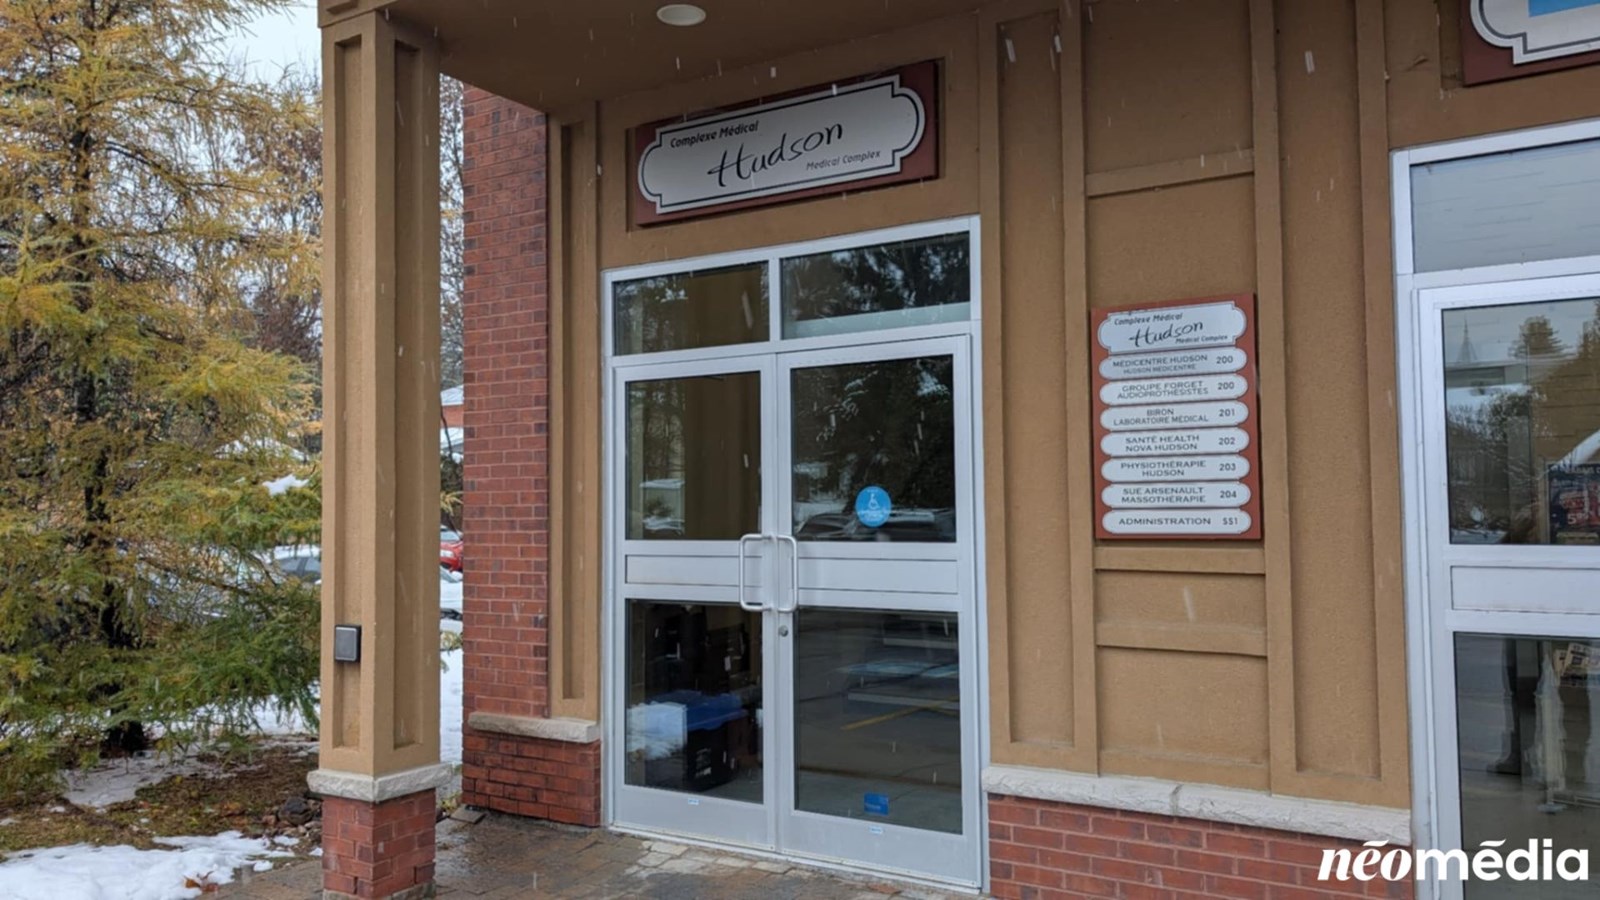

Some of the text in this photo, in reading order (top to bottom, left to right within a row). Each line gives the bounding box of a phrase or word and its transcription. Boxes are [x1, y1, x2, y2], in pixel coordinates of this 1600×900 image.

[670, 120, 759, 149] Complexe Médical
[707, 123, 843, 187] Hudson
[806, 150, 881, 171] Medical Complex
[1114, 312, 1183, 326] Complexe Médical
[1128, 321, 1204, 347] Hudson
[1175, 336, 1200, 344] Medical
[1170, 354, 1208, 363] HUDSON
[1216, 355, 1234, 364] 200
[1122, 380, 1235, 392] GROUPE FORGET 200
[1146, 408, 1235, 417] BIRON 201
[1113, 416, 1170, 426] LABORATOIRE
[1125, 434, 1236, 445] SANTÉ HEALTH 202
[1125, 443, 1198, 452] NOVA HUDSON
[1219, 463, 1236, 471] 203
[1142, 469, 1185, 477] HUDSON
[1122, 487, 1237, 499] SUE ARSENAULT 204
[1118, 517, 1211, 525] ADMINISTRATION
